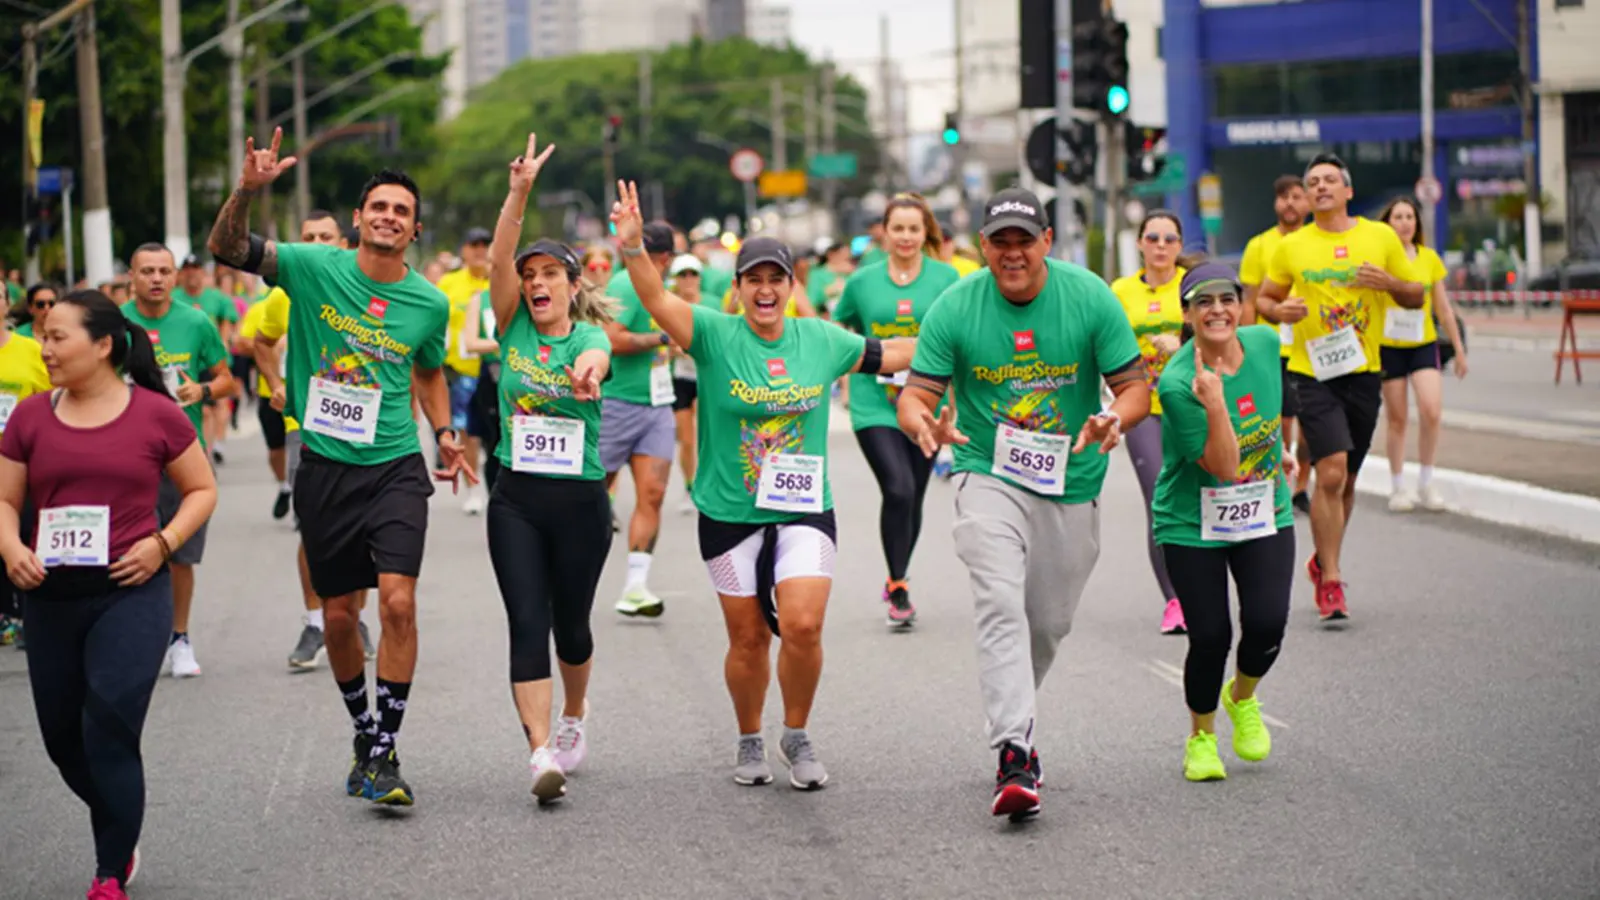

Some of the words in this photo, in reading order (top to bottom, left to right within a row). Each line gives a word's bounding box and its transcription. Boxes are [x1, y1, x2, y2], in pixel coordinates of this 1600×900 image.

[991, 201, 1036, 216] adidas
[320, 397, 364, 421] 5908
[524, 433, 566, 452] 5911
[1009, 447, 1056, 472] 5639
[774, 472, 813, 491] 5638
[1216, 500, 1261, 521] 7287
[50, 529, 93, 549] 5112
